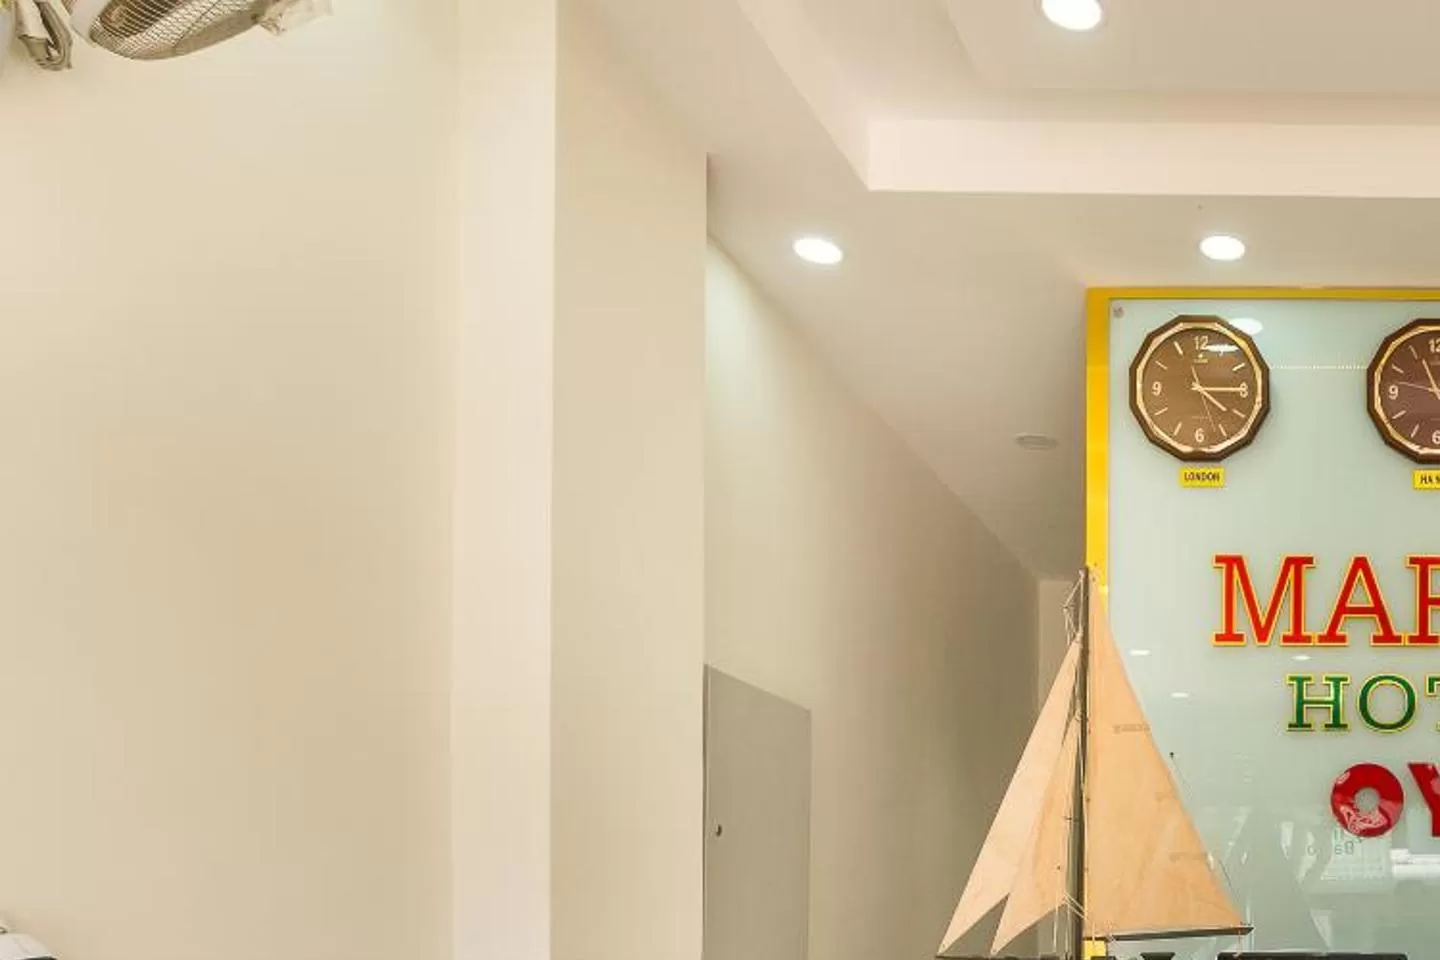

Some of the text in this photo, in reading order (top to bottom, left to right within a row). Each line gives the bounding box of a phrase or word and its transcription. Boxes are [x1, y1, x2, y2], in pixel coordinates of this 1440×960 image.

[1193, 335, 1209, 350] 12
[1152, 381, 1162, 396] 9
[1388, 384, 1399, 400] 9
[1194, 428, 1205, 442] 6
[1184, 471, 1220, 482] LONDON
